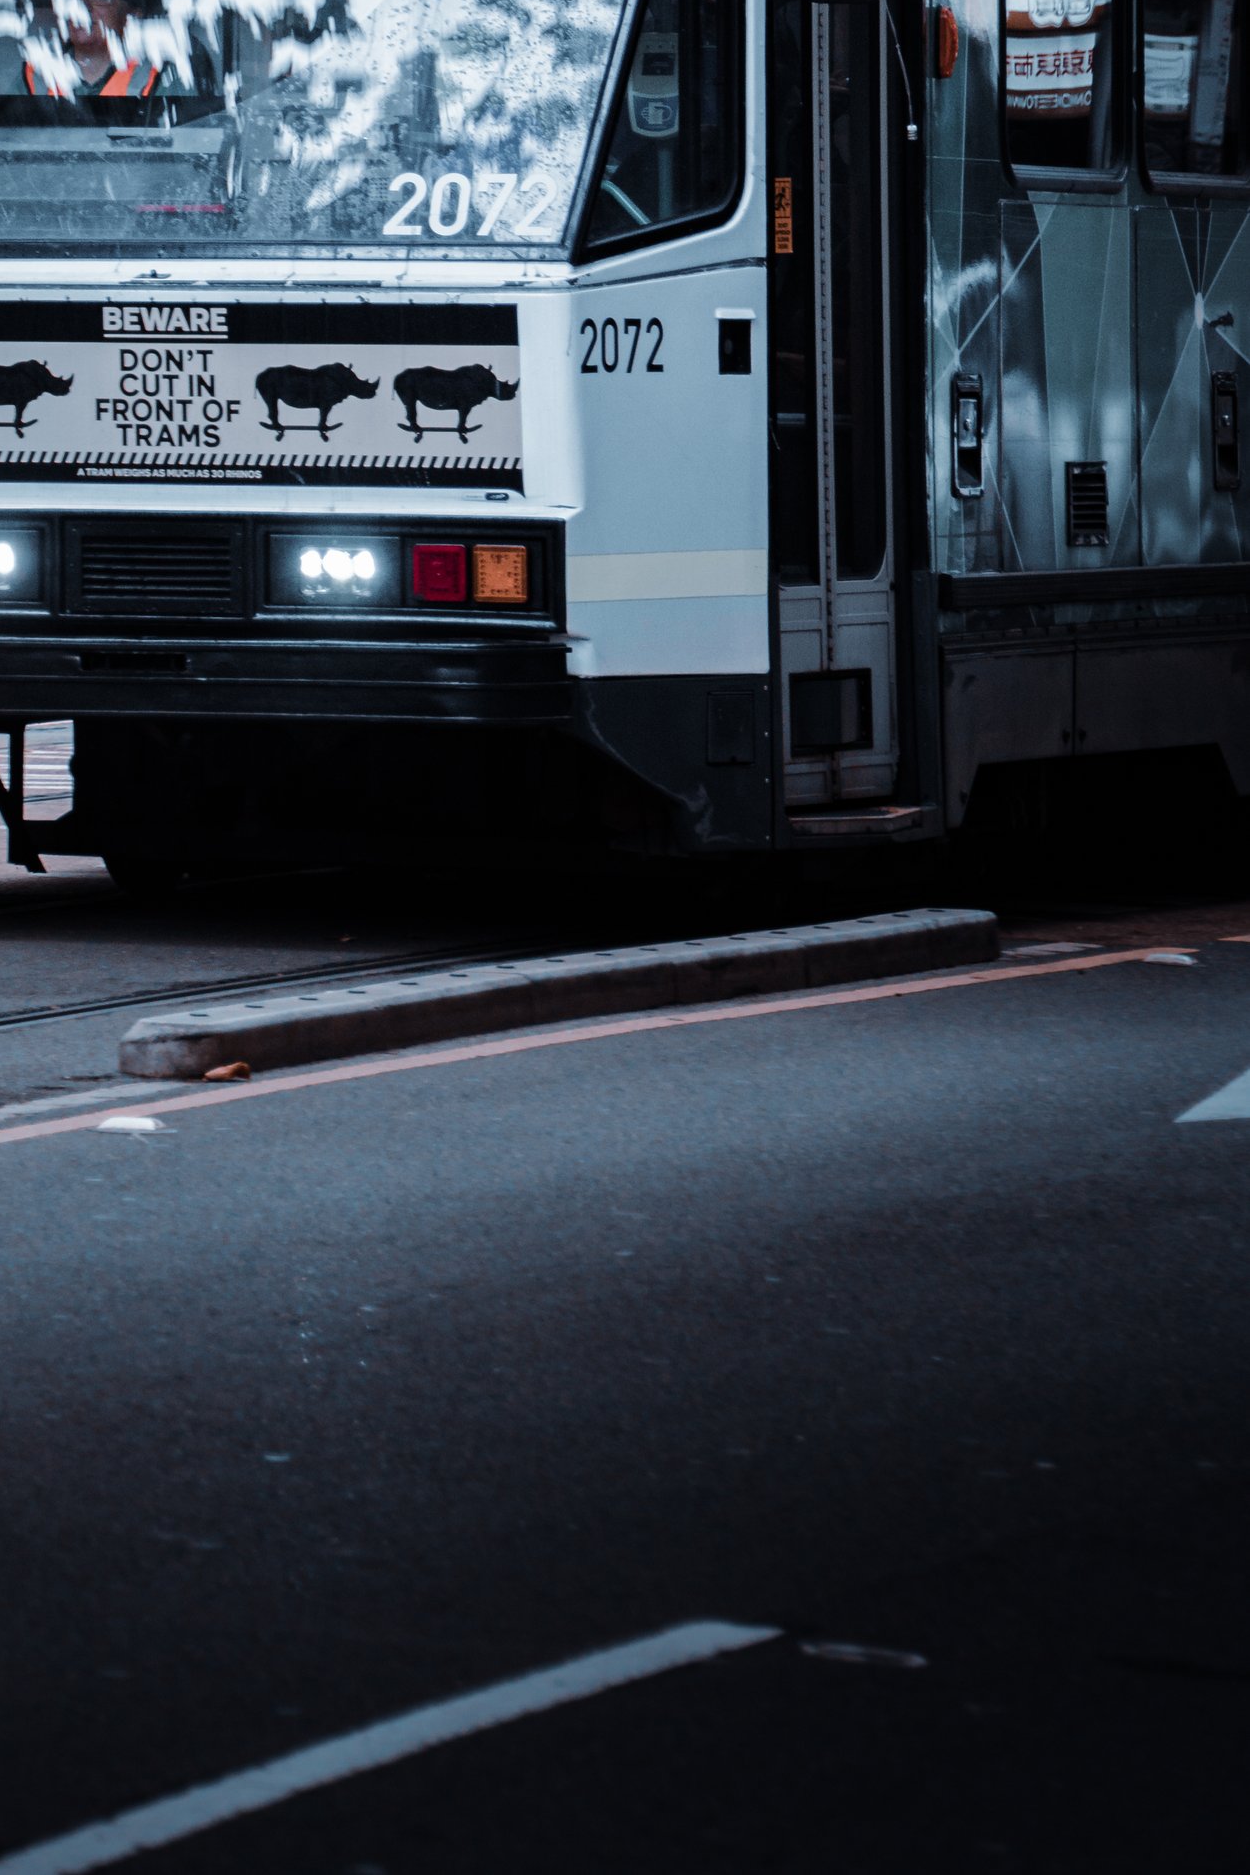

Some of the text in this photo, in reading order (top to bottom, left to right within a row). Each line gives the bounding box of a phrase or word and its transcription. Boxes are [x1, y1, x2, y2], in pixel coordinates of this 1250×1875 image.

[381, 172, 559, 238] 2072
[102, 306, 228, 332] BEWARE
[580, 318, 665, 374] 2072
[119, 349, 213, 372] DON'T
[119, 373, 216, 398] CUT IN
[96, 398, 241, 423] FRONT OF
[116, 424, 221, 447] TRAMS
[76, 467, 263, 480] A TRAM WEIGHS AS MUCH AS 30 RHINOS
